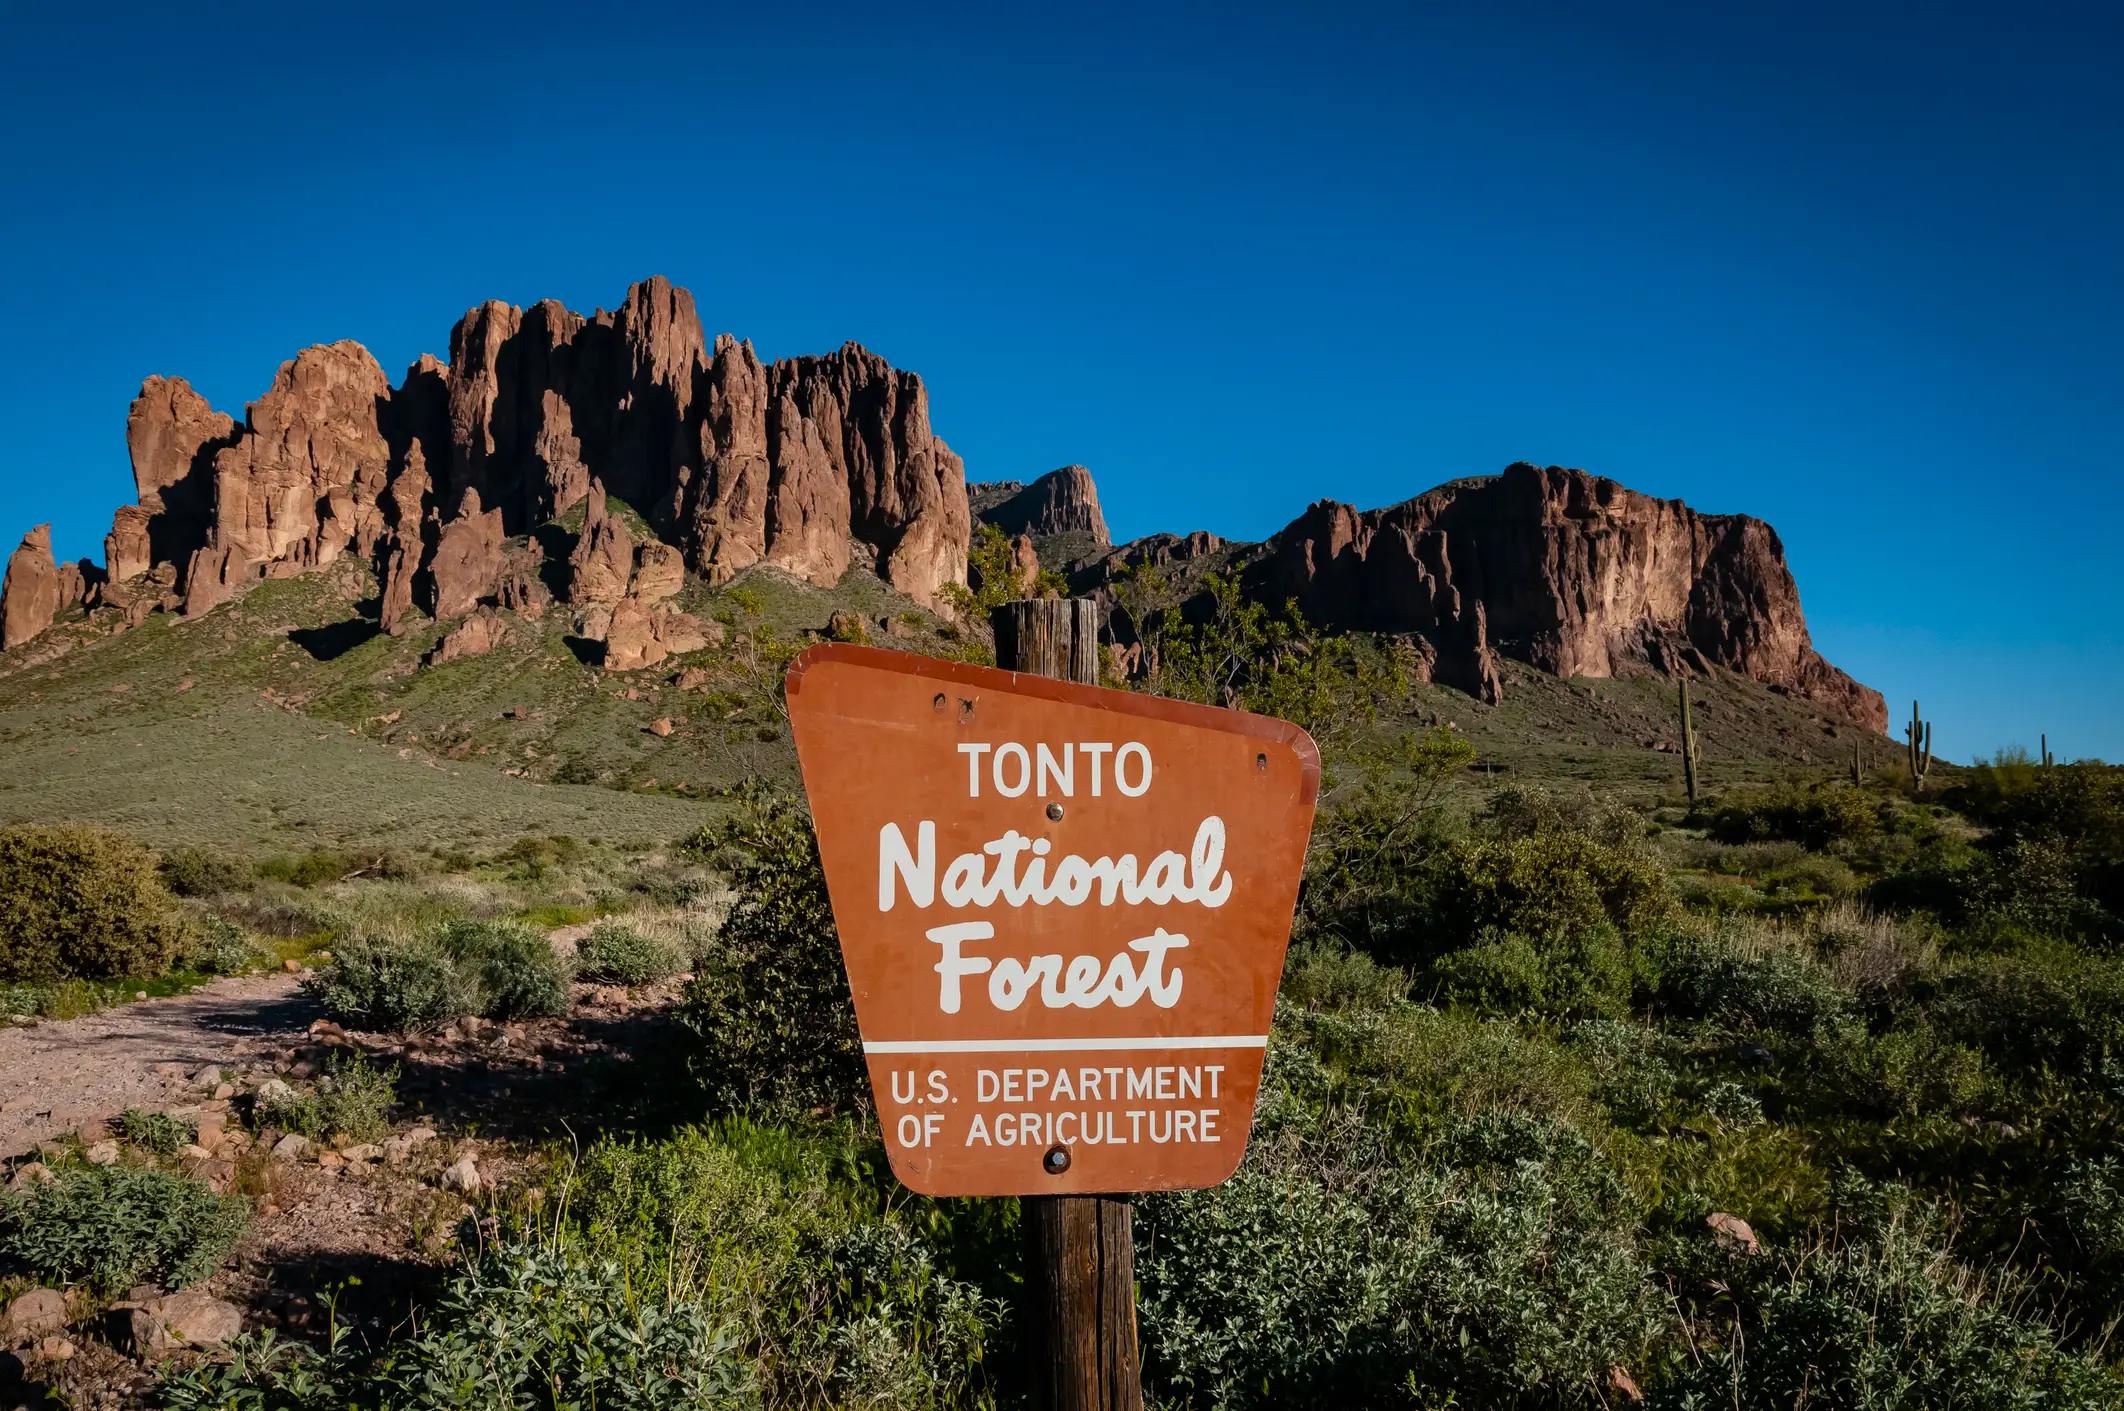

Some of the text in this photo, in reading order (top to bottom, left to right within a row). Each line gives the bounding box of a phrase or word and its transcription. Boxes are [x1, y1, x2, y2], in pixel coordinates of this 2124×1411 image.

[957, 741, 1153, 798] TONTO
[878, 815, 1233, 912] National
[925, 921, 1190, 1015] Forest
[891, 1065, 1225, 1105] U.S. DEPARTMENT
[897, 1109, 1221, 1148] OF AGRICULTURE
